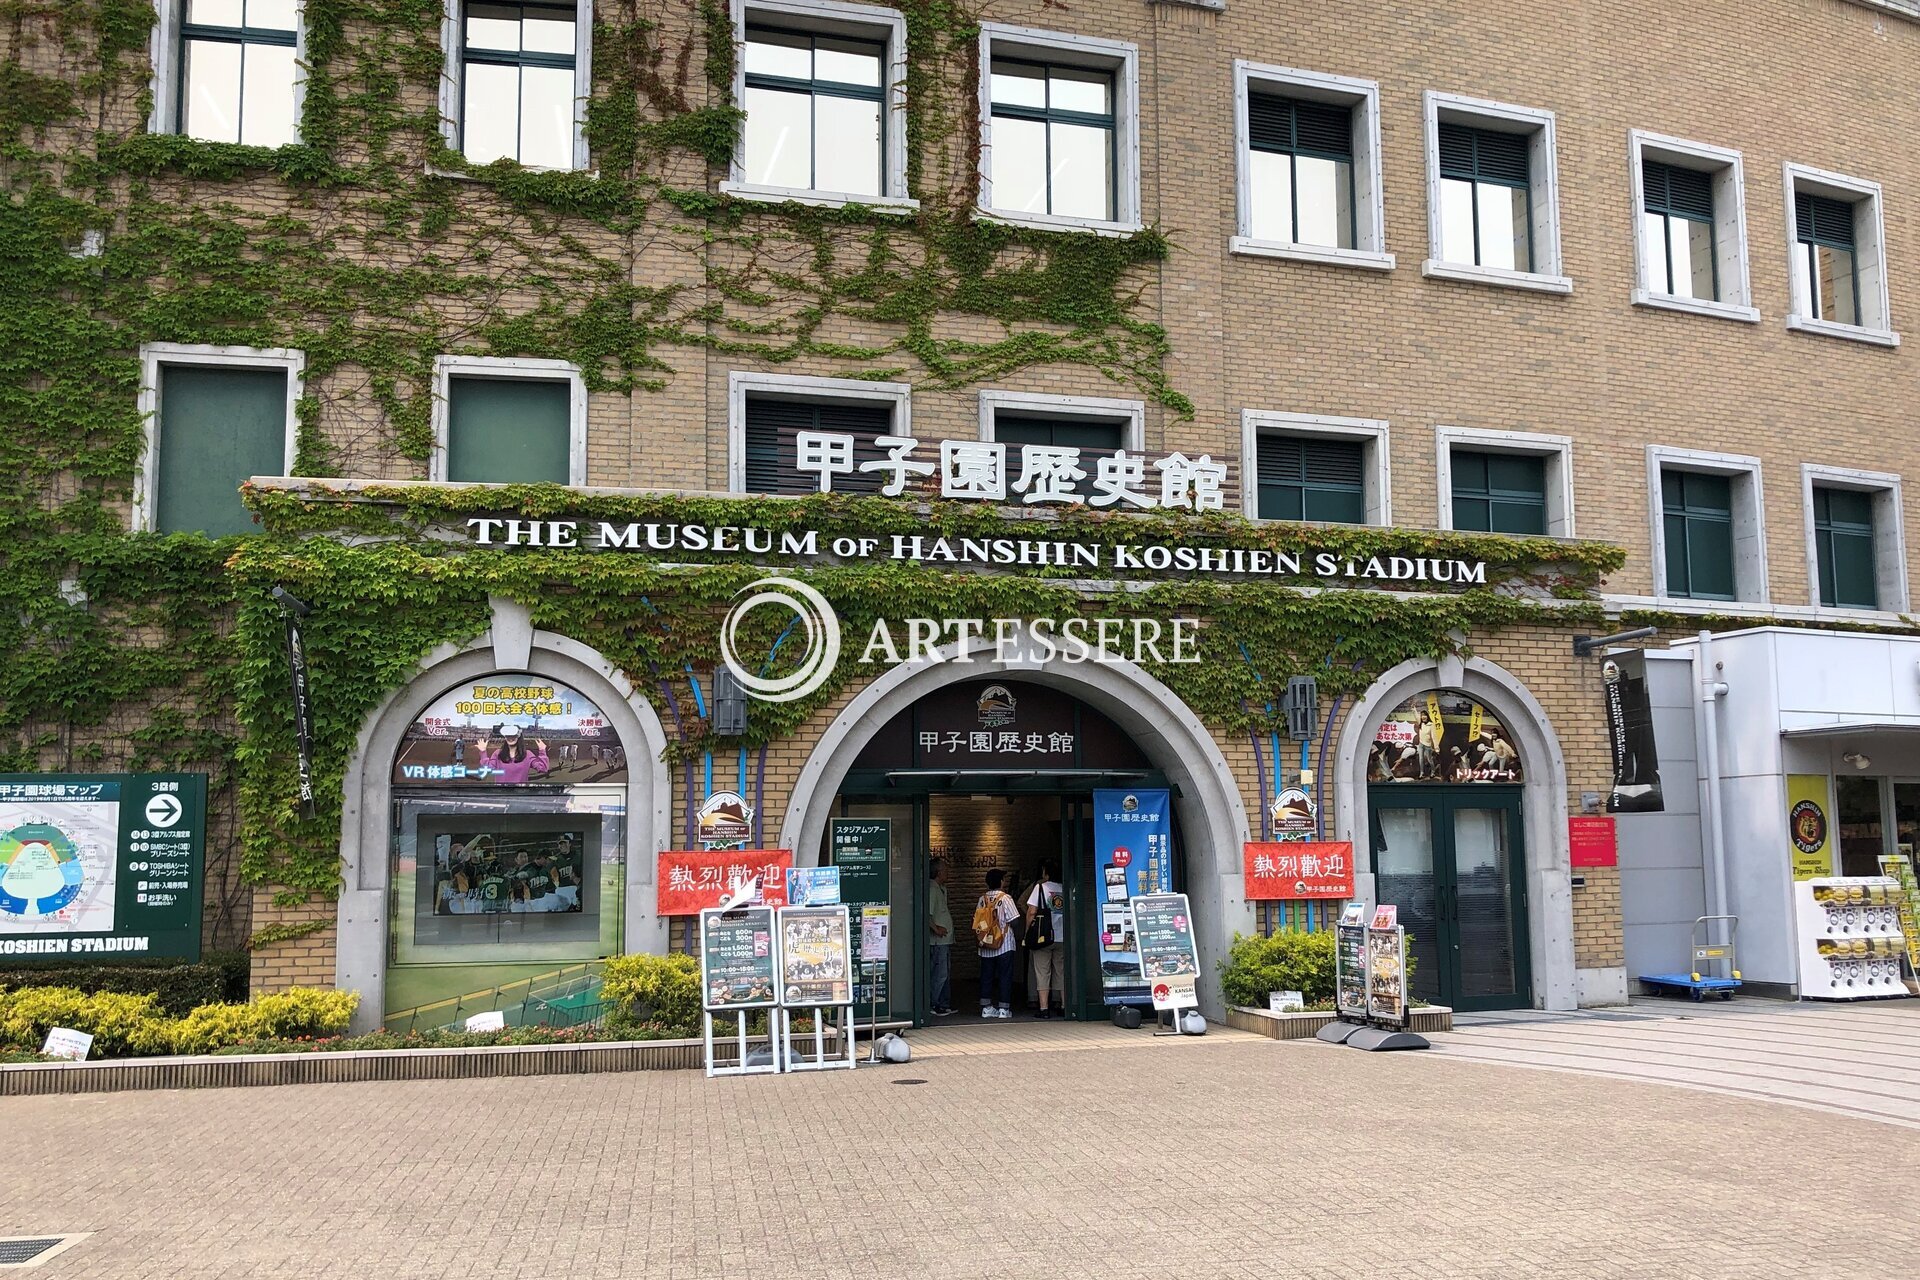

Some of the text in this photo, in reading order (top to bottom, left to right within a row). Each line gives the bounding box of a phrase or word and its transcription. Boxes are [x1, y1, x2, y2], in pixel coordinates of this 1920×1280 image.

[796, 430, 1228, 512] 甲子園歴史館
[466, 518, 1487, 584] THE MUSEUM OF HANSHIN KOSHIEN STADIUM
[472, 685, 555, 700] 夏の高校野球
[424, 717, 451, 727] 開会式
[577, 718, 603, 728] 決勝戦
[427, 726, 449, 736] Ver.
[580, 727, 601, 737] Ver.
[919, 731, 1074, 754] 甲子園歴史館
[1456, 768, 1516, 780] トリックアート
[151, 782, 179, 792] 3塁側
[1792, 802, 1822, 818] HANSHIN
[1104, 813, 1160, 823] 甲子園歴史館
[836, 826, 886, 834] スタジアムツアー
[1796, 838, 1822, 853] Tigers
[1792, 866, 1812, 876] Tigers
[71, 937, 149, 953] STADIUM
